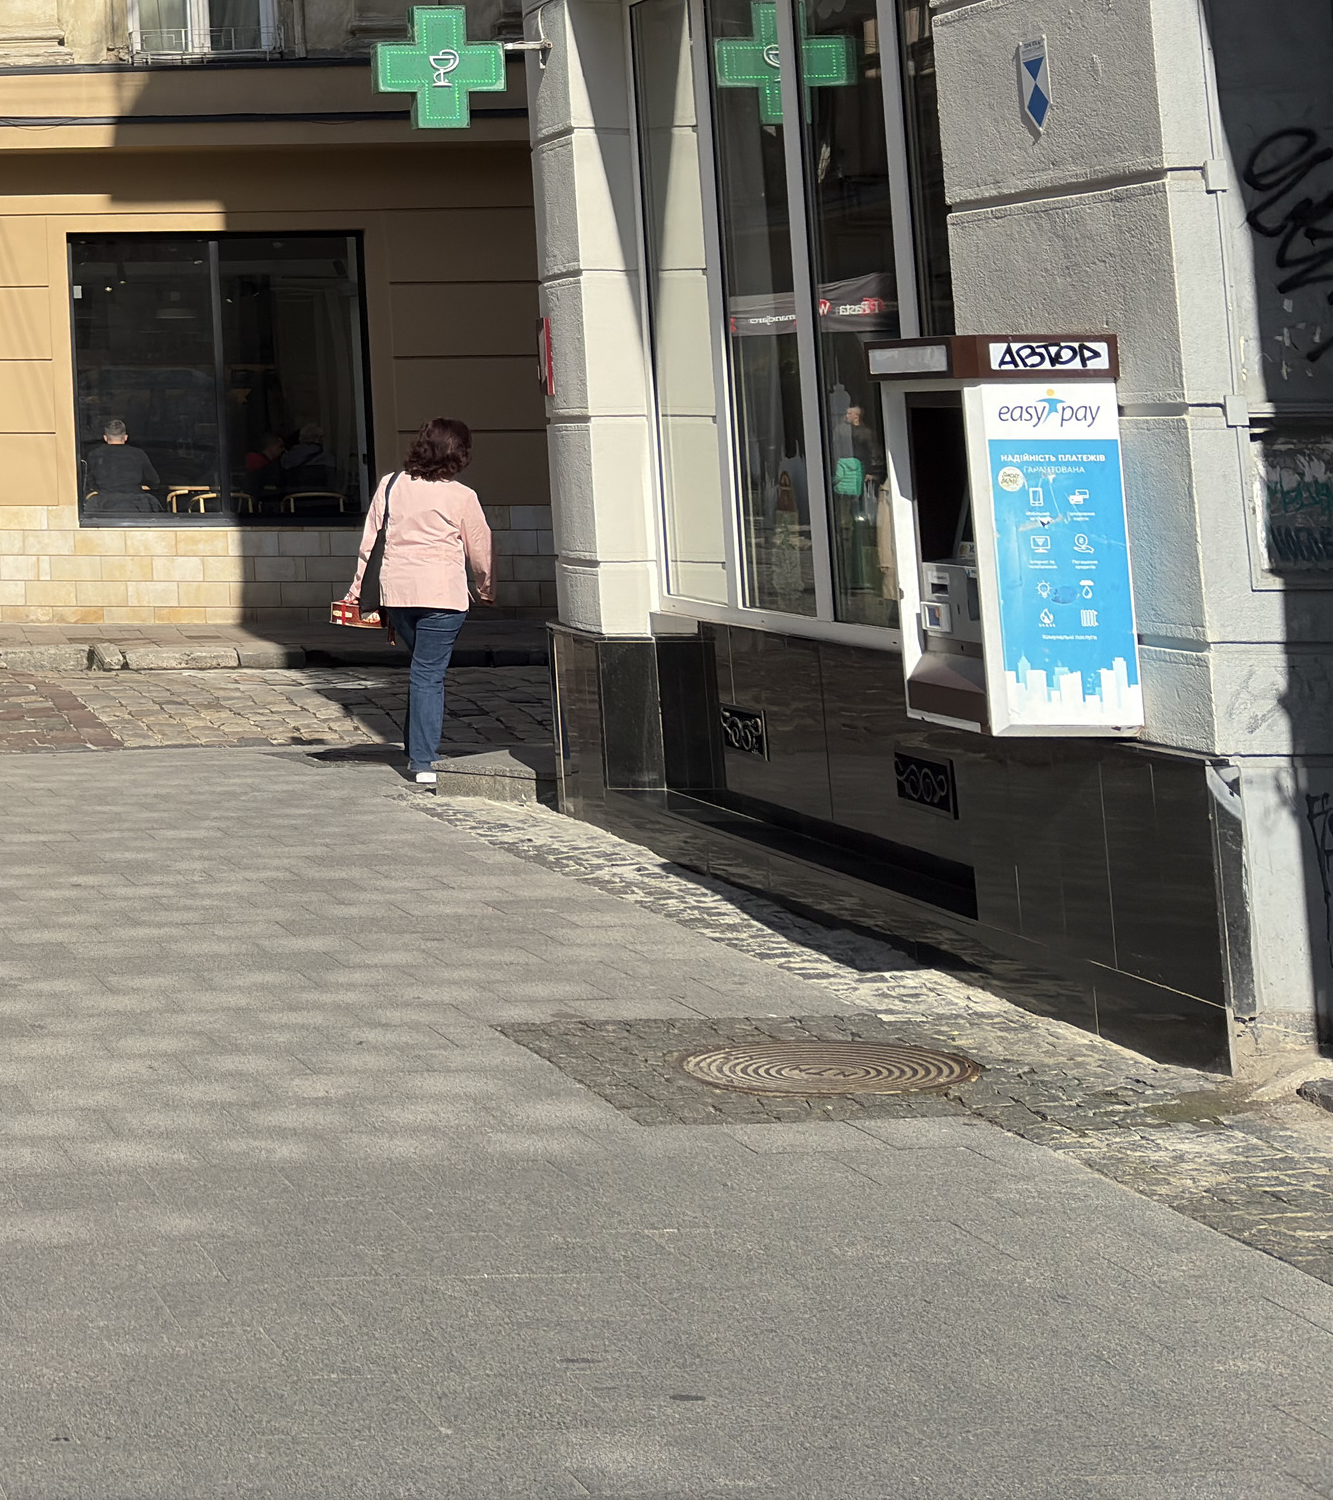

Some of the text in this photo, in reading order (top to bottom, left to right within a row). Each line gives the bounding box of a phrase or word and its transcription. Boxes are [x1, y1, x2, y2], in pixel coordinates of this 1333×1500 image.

[998, 342, 1102, 368] АВТОР
[998, 405, 1101, 427] easy pay
[1000, 453, 1106, 463] НАДІЙНІСТЬ ПЛАТЕЖІВ
[1023, 465, 1086, 473] ГАРАНТОВАНА
